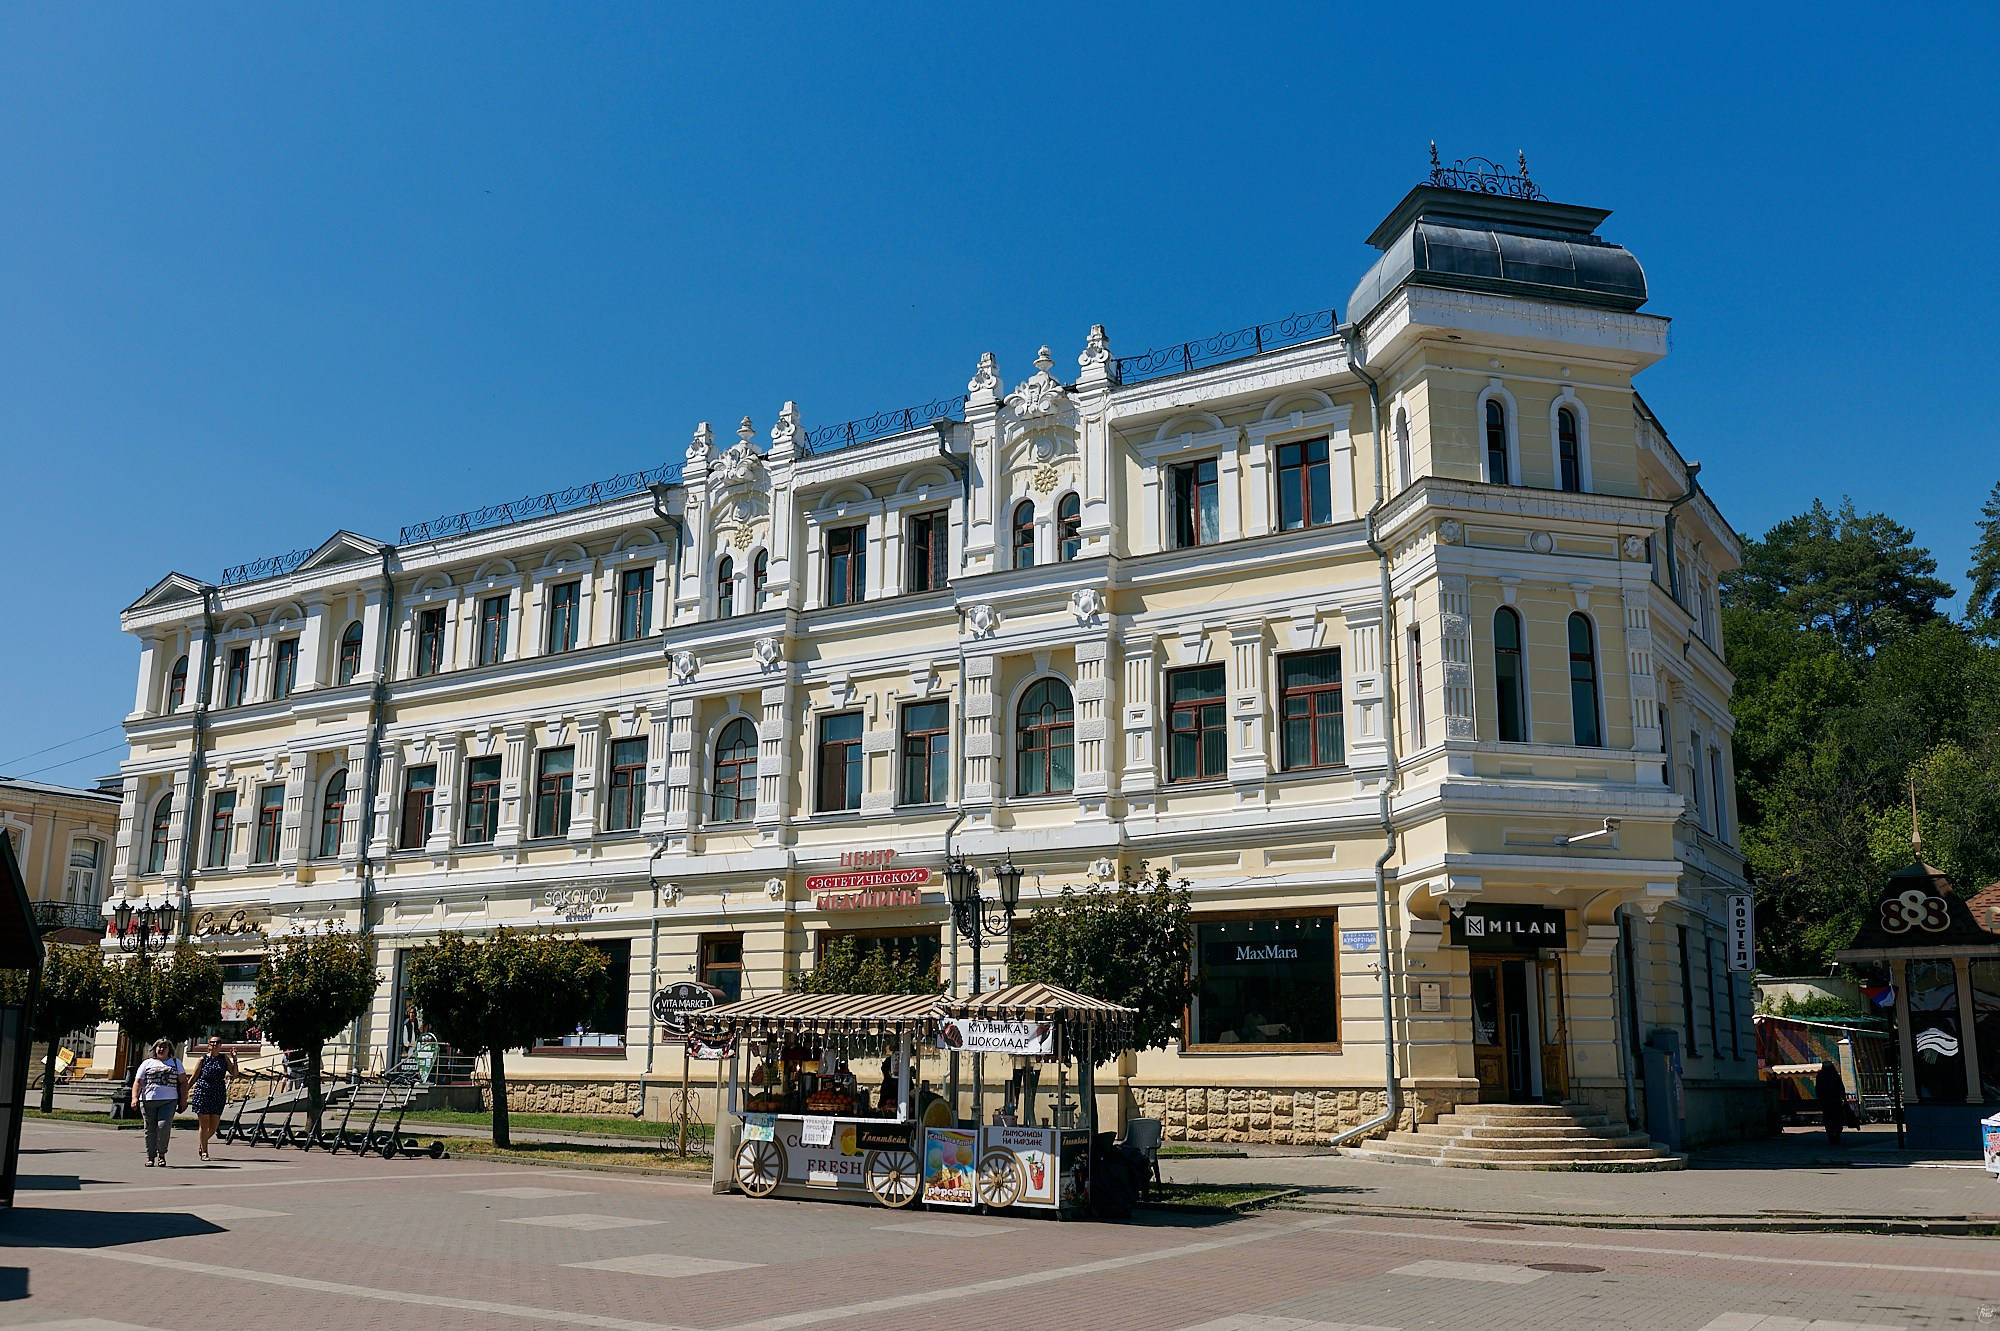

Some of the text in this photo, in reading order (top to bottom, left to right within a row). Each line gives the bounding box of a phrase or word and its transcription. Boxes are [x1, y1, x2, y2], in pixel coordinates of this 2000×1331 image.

[840, 849, 897, 867] ЦЕНТР
[816, 870, 918, 888] ЭСТЕТИЧЕСКОЙ
[544, 887, 608, 906] SOKOLOV
[816, 889, 921, 910] МЕДИЦИНЫ
[1881, 890, 1950, 933] 888
[1489, 921, 1556, 934] MILAN
[1735, 898, 1747, 960] ХОСТЕЛ
[1236, 945, 1298, 960] MaxMara
[661, 999, 710, 1009] VITA MARKET
[1023, 1025, 1030, 1035] В
[968, 1036, 1029, 1049] ШОКОЛАДЕ
[1002, 1129, 1043, 1138] ЛИМОНАДЫ
[1013, 1138, 1043, 1147] НАРЗАНЕ
[807, 1159, 862, 1175] FRESH
[928, 1187, 971, 1198] popcorn
